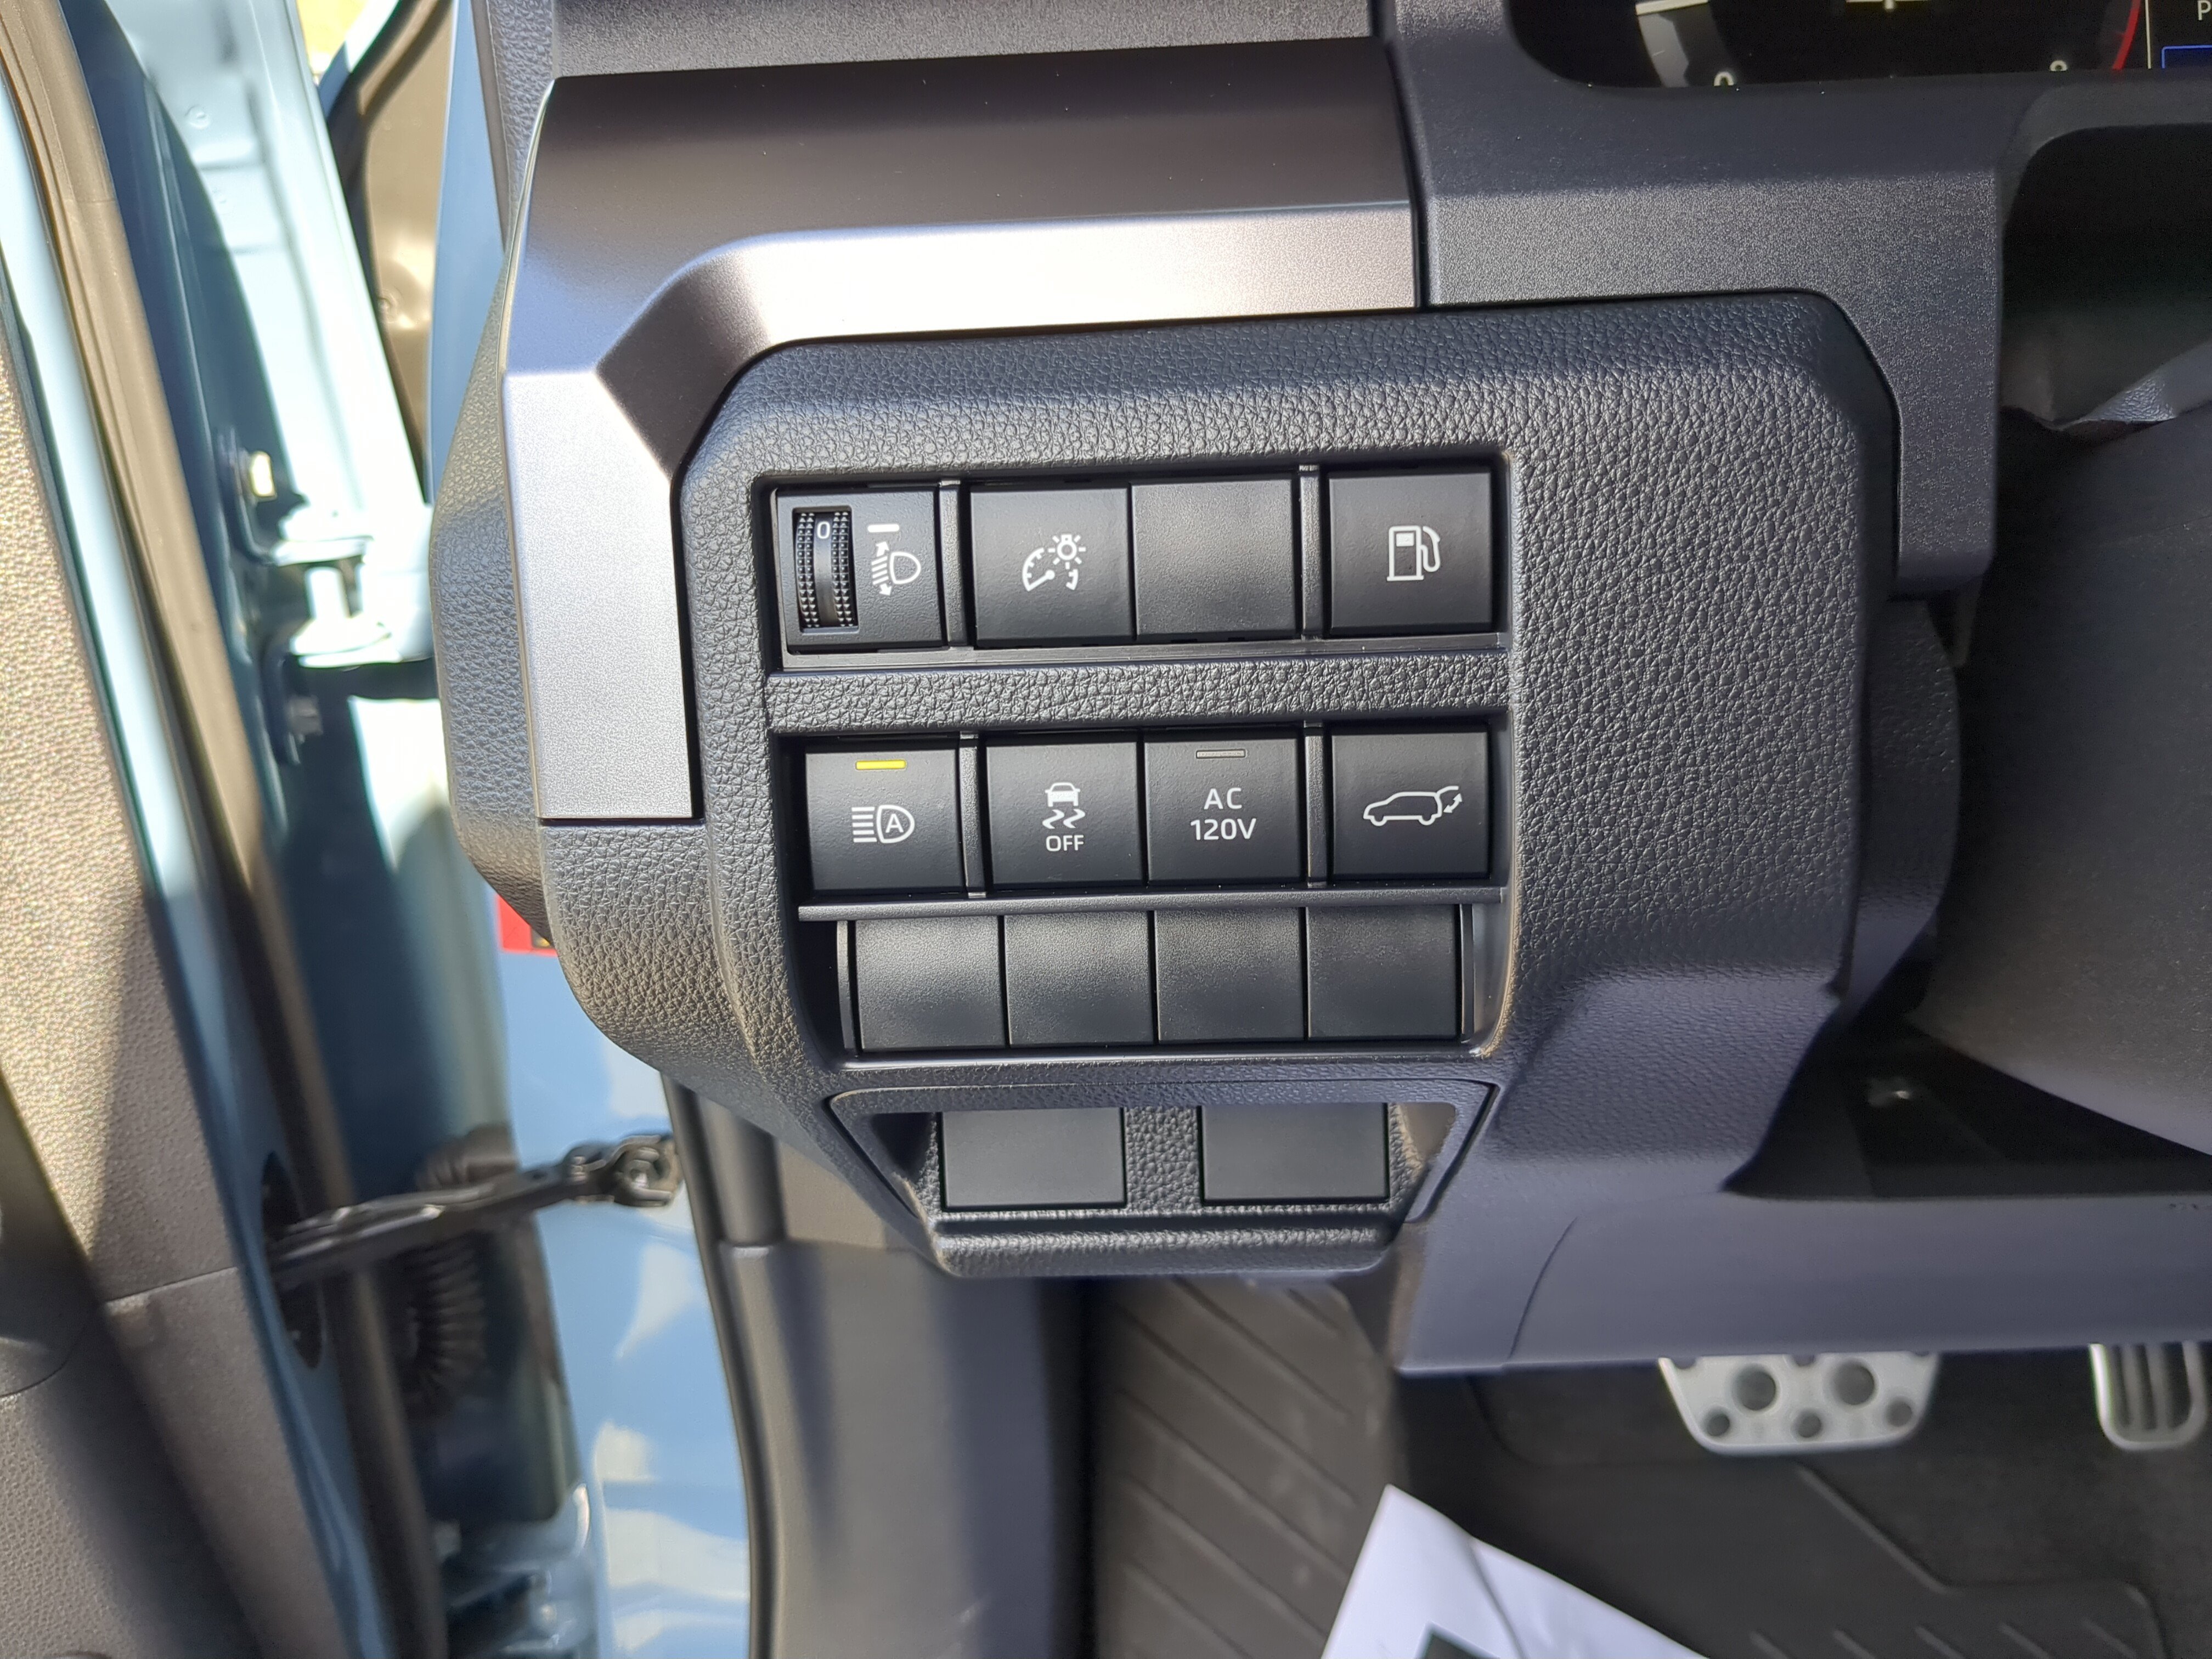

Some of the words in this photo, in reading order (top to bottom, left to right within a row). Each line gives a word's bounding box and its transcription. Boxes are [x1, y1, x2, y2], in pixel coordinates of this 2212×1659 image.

[2197, 0, 2212, 20] P
[817, 521, 830, 539] 0
[1204, 787, 1243, 810] AC
[885, 814, 904, 833] A
[1190, 817, 1257, 840] 120V
[1046, 834, 1084, 851] OFF
